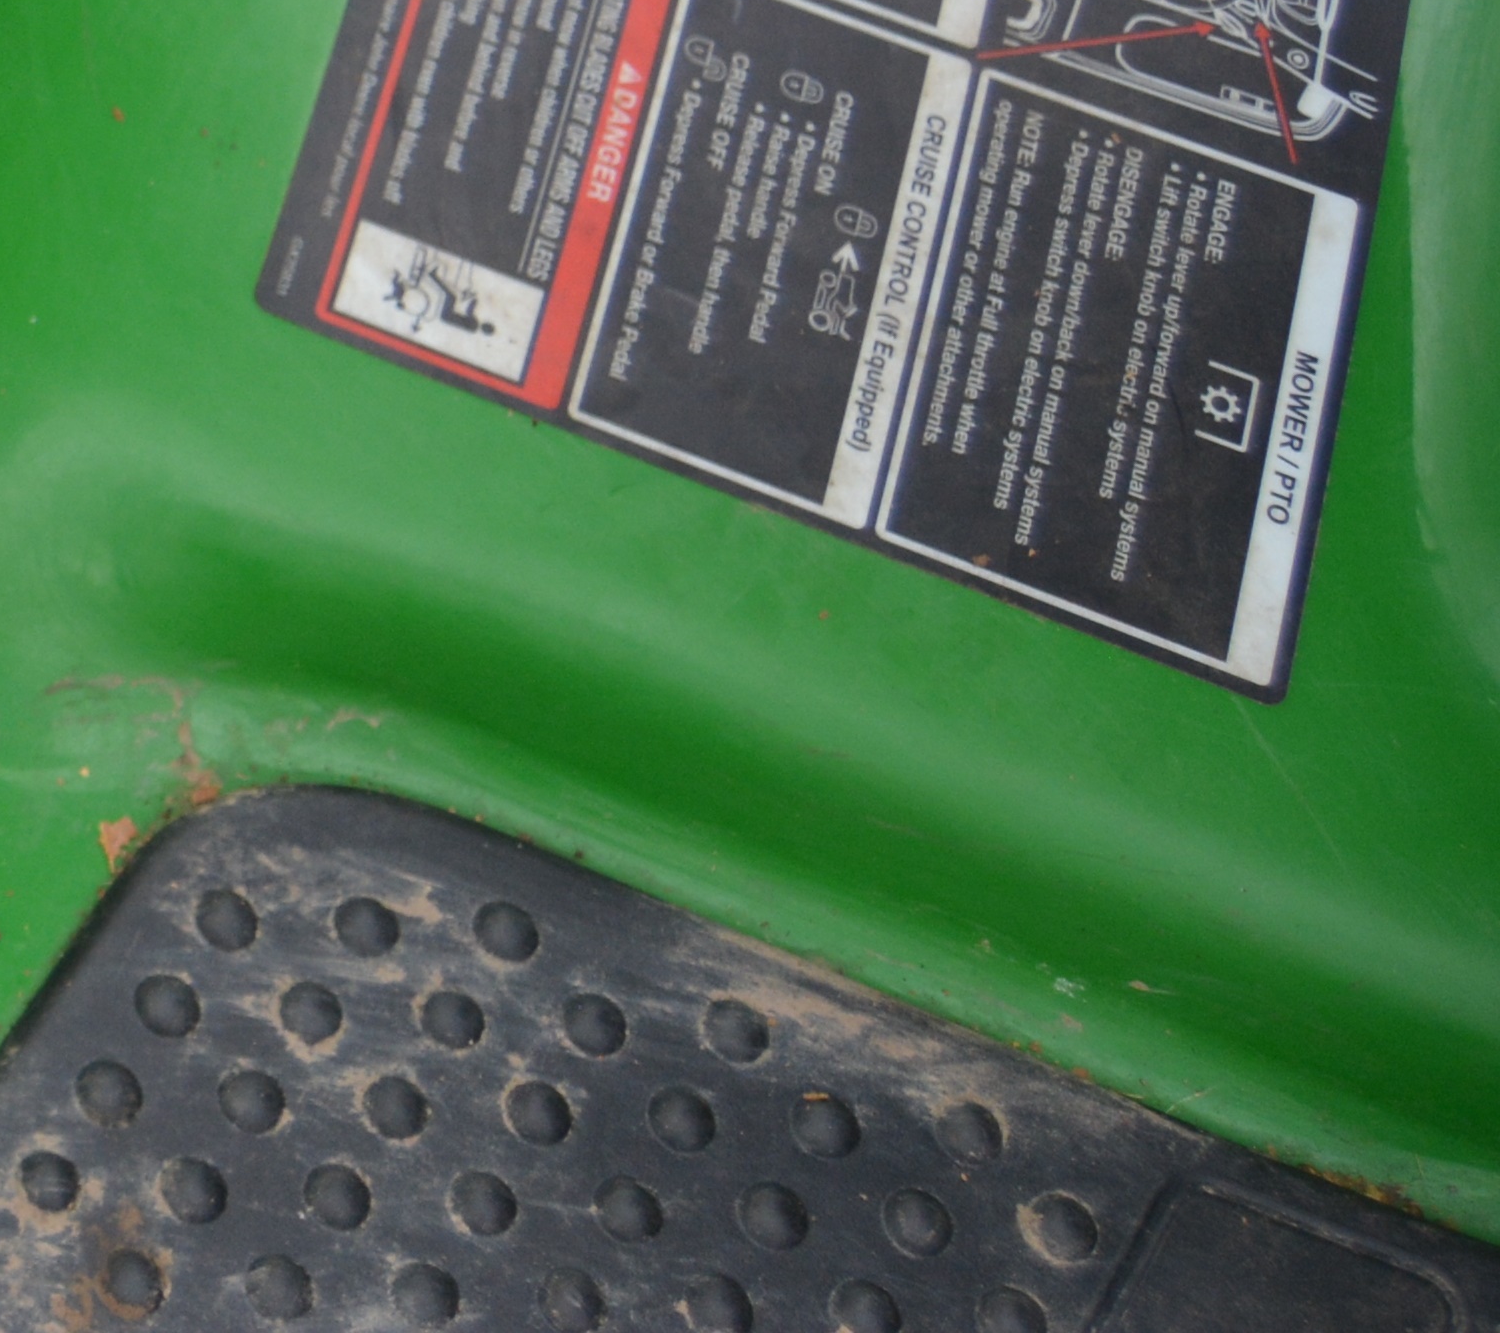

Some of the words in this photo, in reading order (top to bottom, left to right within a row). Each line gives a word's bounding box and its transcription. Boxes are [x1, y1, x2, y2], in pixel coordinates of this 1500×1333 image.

[716, 53, 749, 126] CRUISE
[587, 87, 637, 201] DANGER
[667, 90, 701, 164] Depress
[707, 129, 730, 170] OFF
[731, 114, 765, 186] Release
[762, 124, 790, 175] Raise
[821, 91, 853, 162] CRUISE
[910, 114, 946, 196] CRUISE
[978, 99, 1012, 184] operating
[1016, 110, 1044, 166] NOTE:
[782, 133, 816, 207] Depress
[814, 164, 835, 194] ON
[1007, 168, 1032, 206] Run
[1058, 140, 1089, 214] Depress
[1087, 150, 1115, 210] Rotate
[1159, 174, 1181, 205] Lift
[646, 166, 681, 243] Forward
[715, 186, 742, 241] pedal,
[746, 177, 777, 238] handle
[968, 185, 993, 250] mower
[1104, 147, 1143, 260] DISENGAGE:
[1179, 183, 1208, 243] Rotate
[1204, 179, 1236, 263] ENGAGE:
[641, 244, 656, 266] or
[762, 209, 796, 288] Forward
[883, 200, 926, 305] CONTROL
[963, 250, 978, 273] or
[993, 208, 1018, 269] engine
[1045, 217, 1069, 277] switch
[1077, 212, 1102, 258] lever
[1147, 207, 1171, 266] switch
[624, 267, 655, 322] Brake
[705, 247, 730, 288] then
[988, 271, 1005, 292] at
[1137, 269, 1162, 316] knob
[1170, 246, 1195, 293] lever
[688, 290, 720, 353] handle
[748, 287, 777, 343] Pedal
[876, 312, 900, 339] (If
[951, 274, 974, 325] other
[980, 294, 1003, 331] Full
[1033, 279, 1060, 326] knob
[1054, 260, 1090, 361] down/back
[609, 325, 639, 380] Pedal
[1028, 329, 1044, 354] on
[1131, 319, 1147, 344] on
[1149, 294, 1181, 398] up/forward
[845, 339, 894, 451] Equipped)
[922, 326, 962, 445] attachments.
[964, 331, 994, 399] throttle
[1011, 356, 1041, 427] electric
[1048, 365, 1065, 390] on
[951, 403, 976, 454] when
[1032, 392, 1059, 465] manual
[1143, 399, 1160, 424] on
[1280, 351, 1318, 451] MOWER
[993, 429, 1022, 509] systems
[1098, 419, 1127, 498] systems
[1128, 427, 1154, 499] manual
[1014, 465, 1043, 551] systems
[1266, 470, 1296, 524] PTO
[1110, 501, 1139, 581] systems
